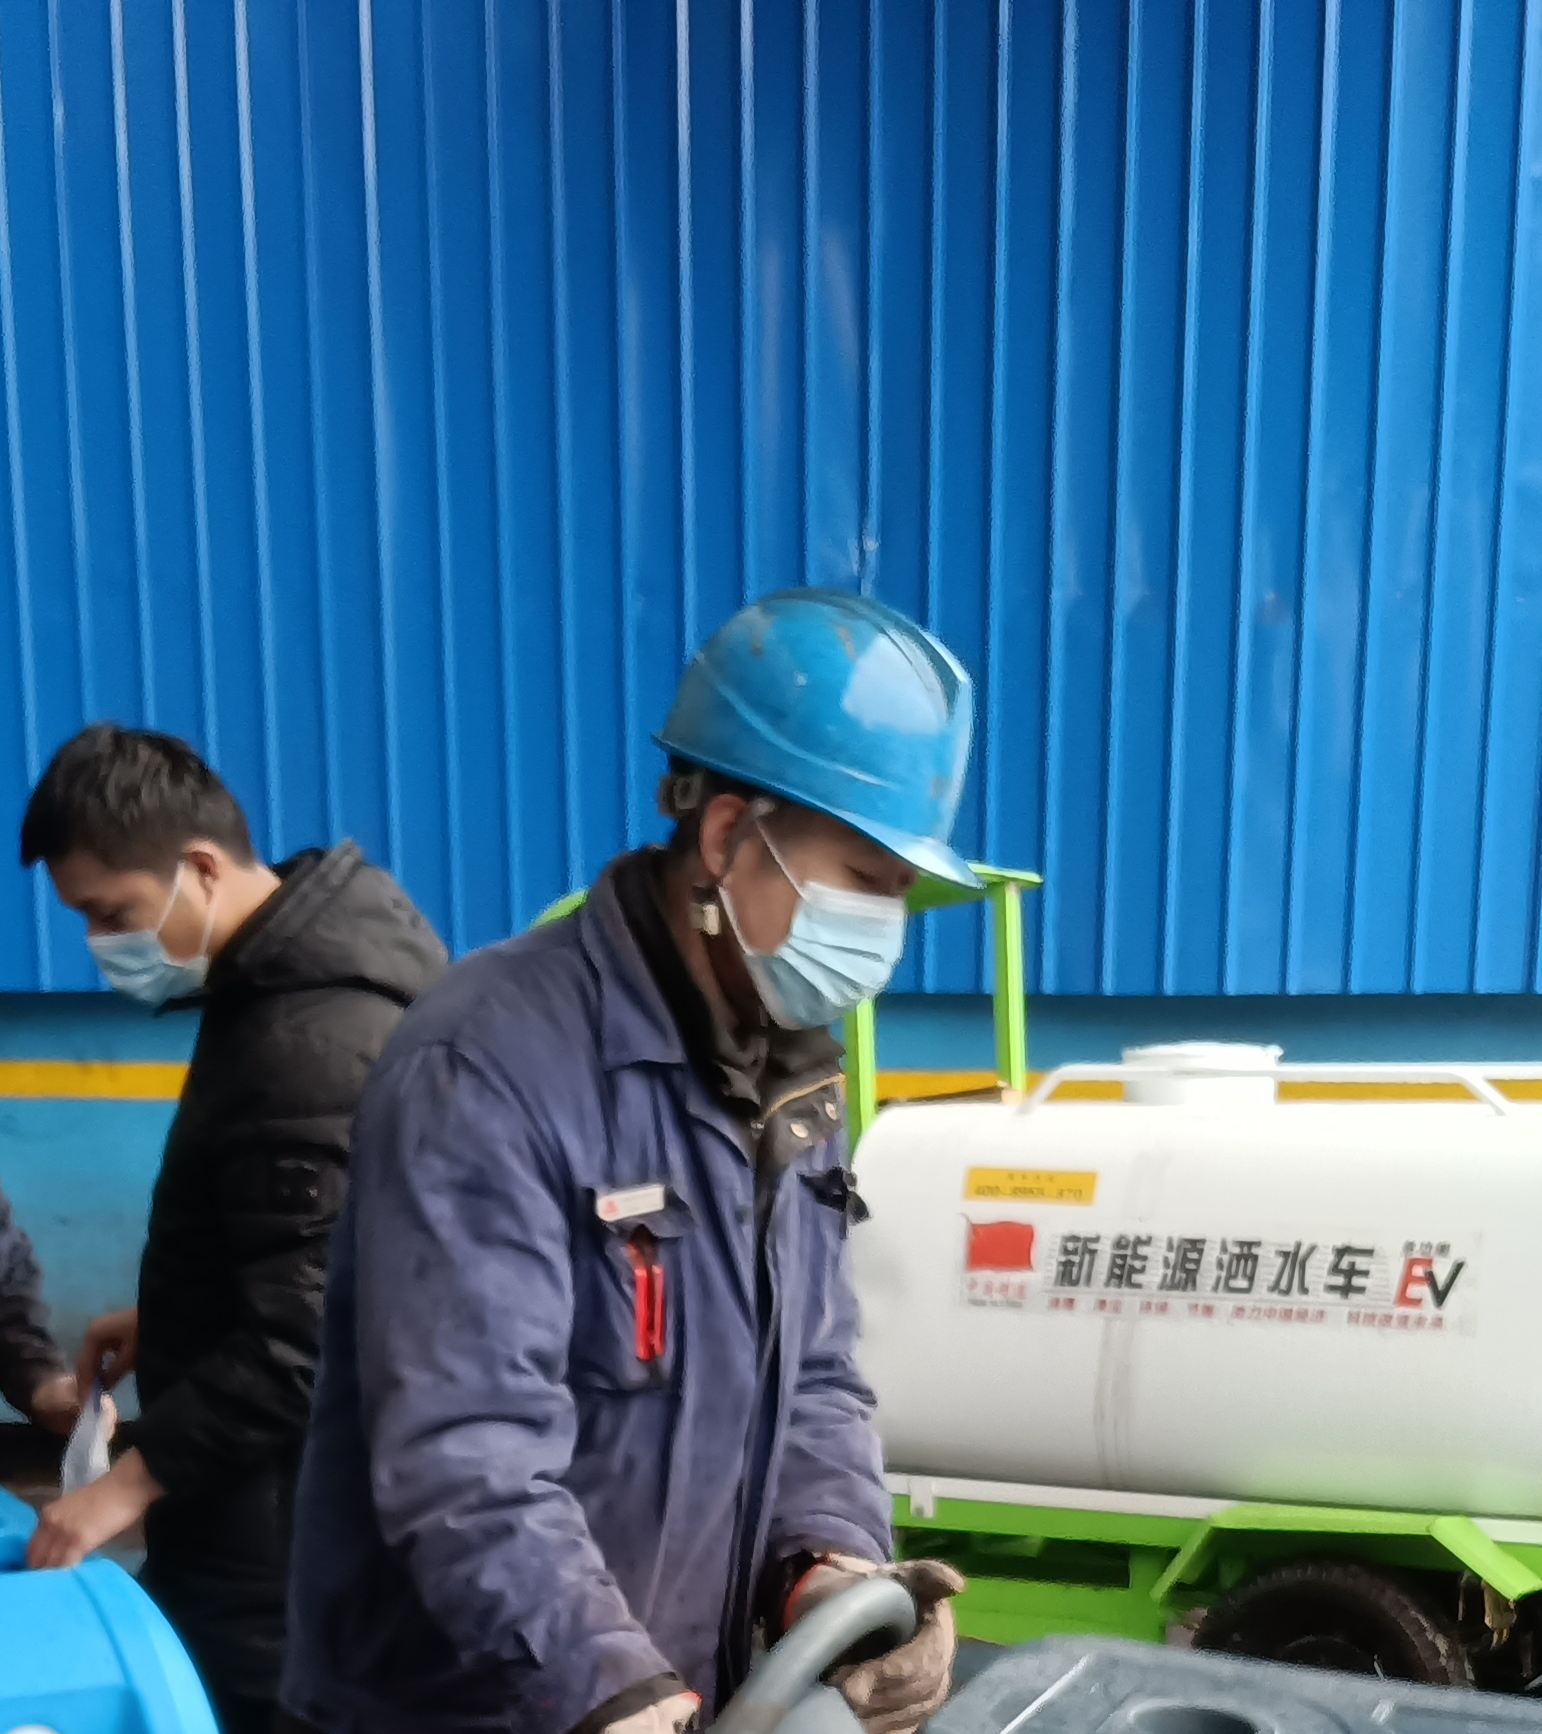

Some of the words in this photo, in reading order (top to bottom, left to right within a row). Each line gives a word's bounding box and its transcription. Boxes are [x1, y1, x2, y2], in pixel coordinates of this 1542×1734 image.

[1054, 1233, 1375, 1299] 新能源洒水车
[1394, 1256, 1466, 1310] EV
